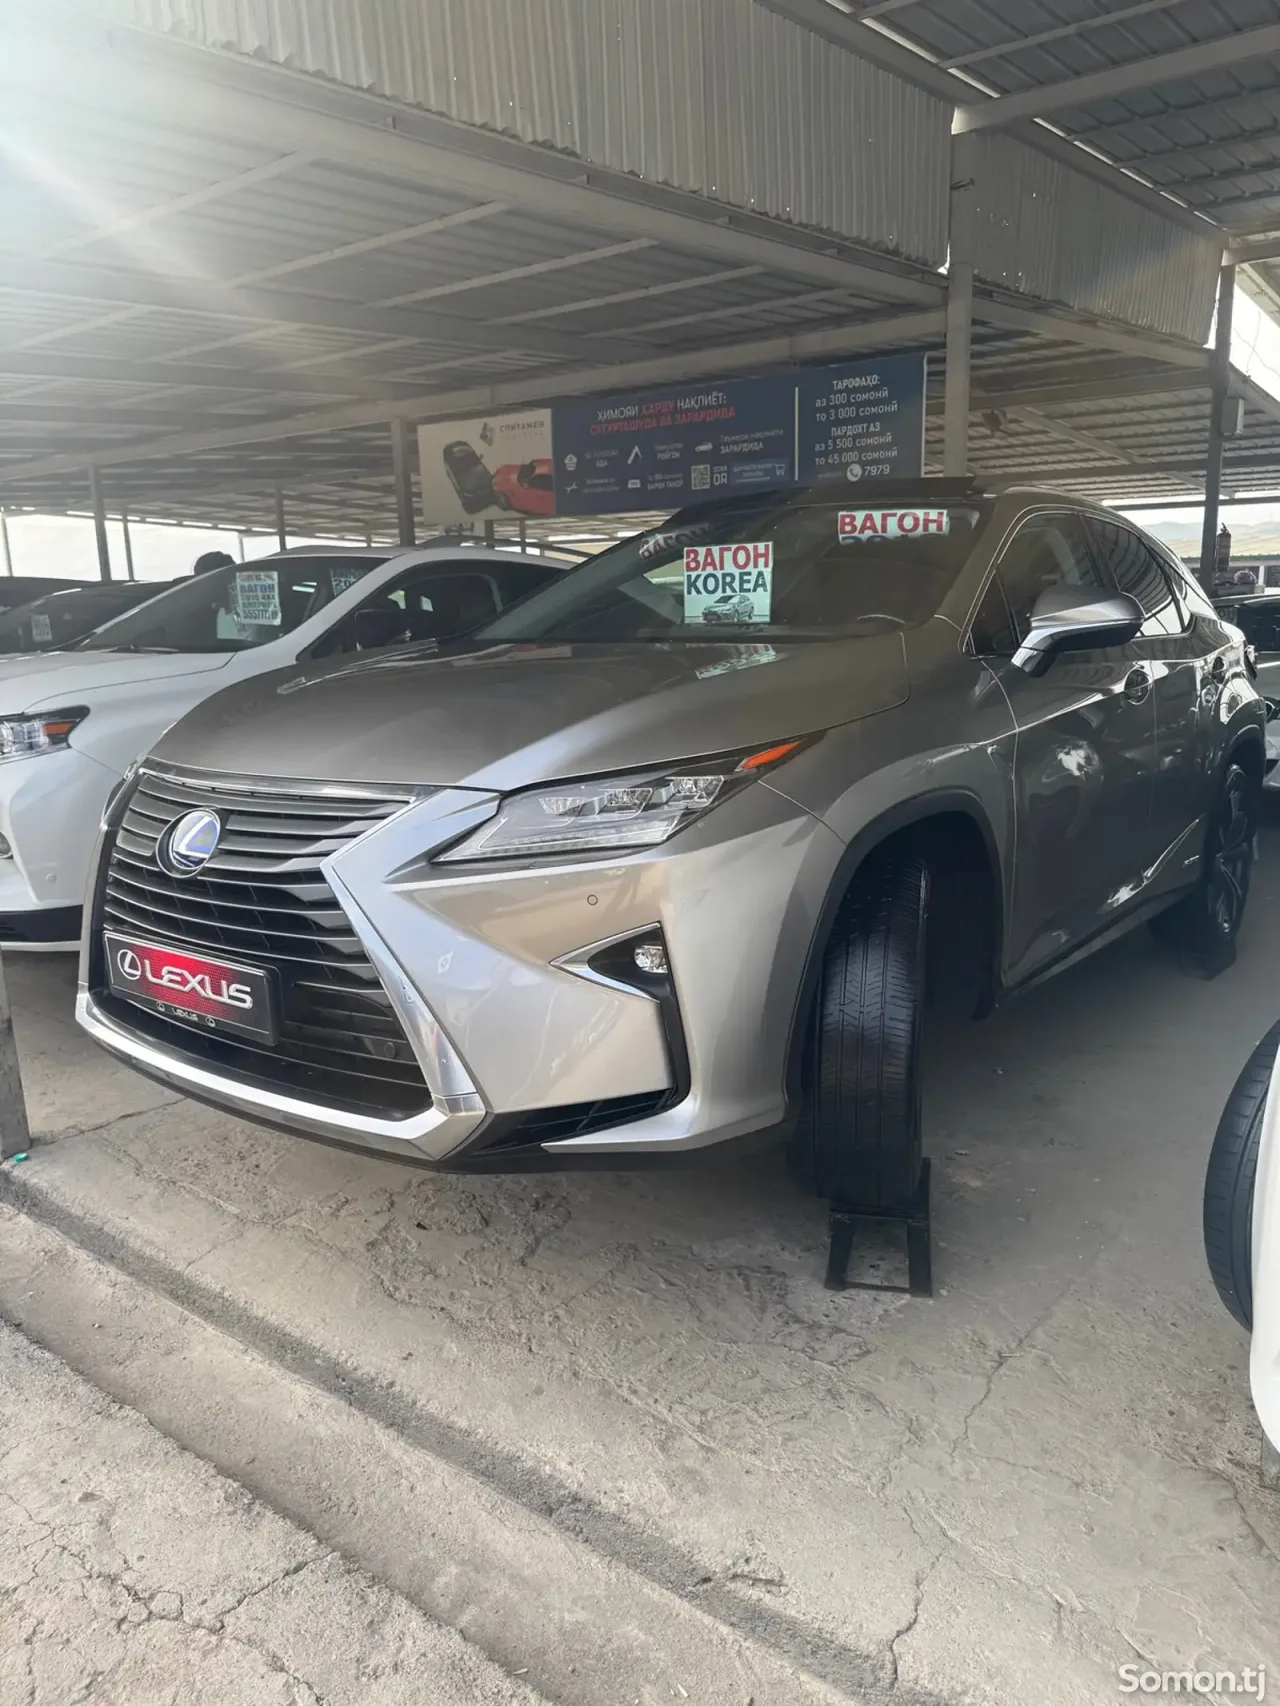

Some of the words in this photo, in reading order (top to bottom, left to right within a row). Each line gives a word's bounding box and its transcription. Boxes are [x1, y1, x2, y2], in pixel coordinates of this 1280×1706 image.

[815, 398, 827, 408] аз
[829, 393, 847, 406] 300
[829, 409, 836, 420] 3
[838, 406, 856, 419] 000
[499, 420, 544, 433] СПИТАМЕН
[831, 422, 868, 437] ПАРДОХТ
[869, 421, 881, 432] АЗ
[814, 442, 825, 452] аз
[827, 439, 834, 450] 5
[836, 437, 853, 449] 500
[814, 457, 825, 466] то
[827, 453, 839, 464] 45
[842, 451, 859, 463] 000
[864, 464, 890, 476] 7979
[839, 511, 944, 535] ВАГОН
[685, 543, 770, 572] ВАГОН
[686, 570, 768, 595] KOREA
[144, 959, 253, 1010] LEXUS
[172, 1007, 199, 1021] LEXUS
